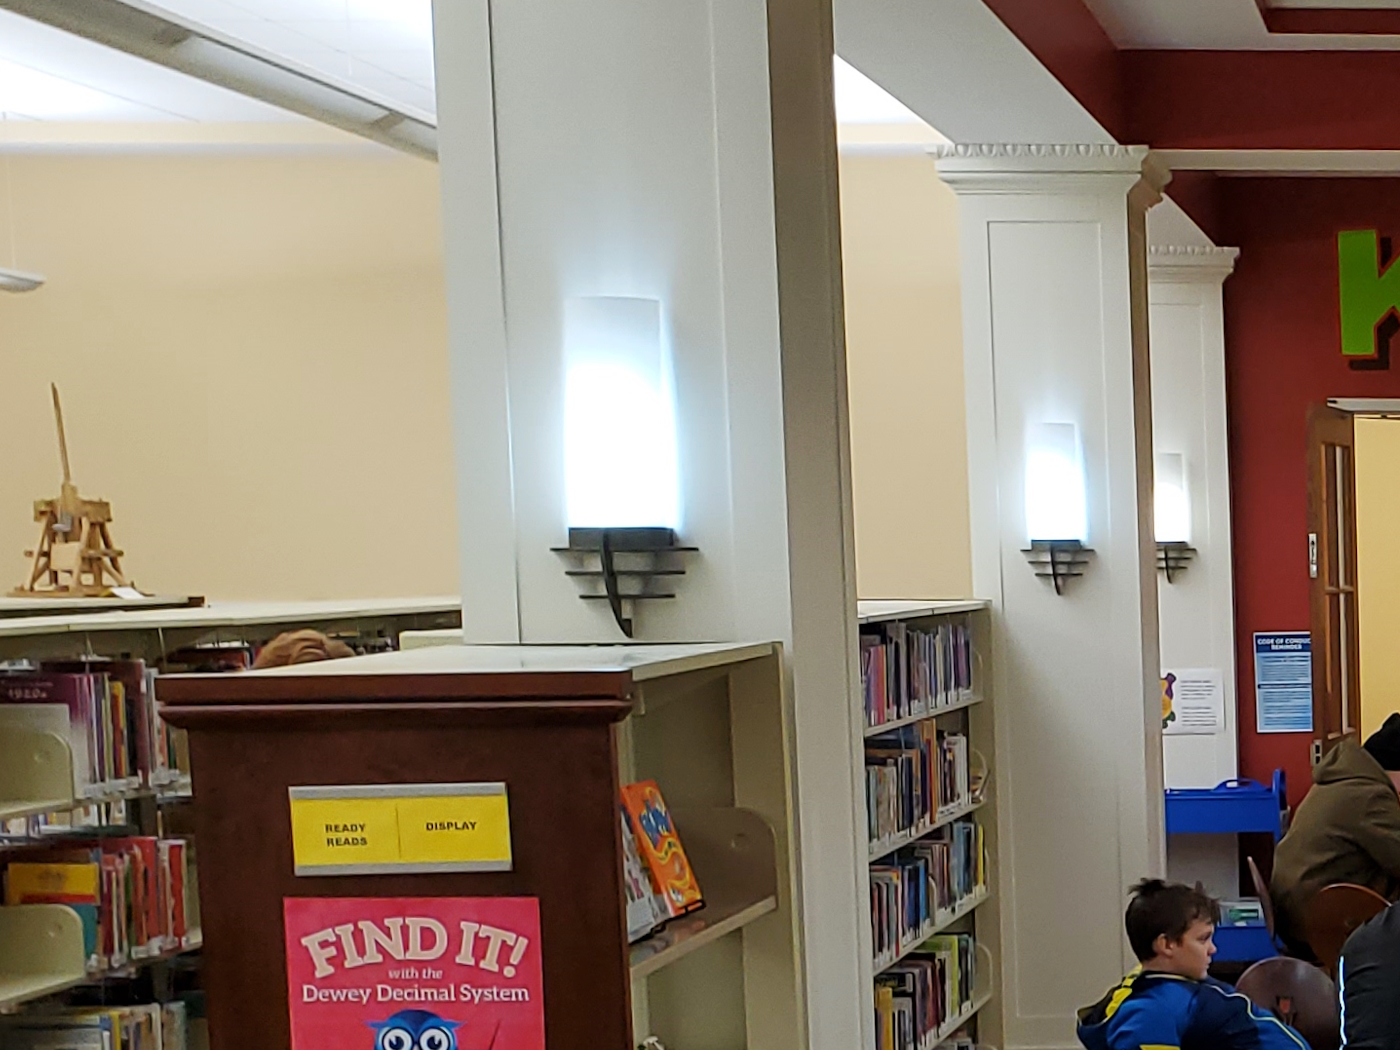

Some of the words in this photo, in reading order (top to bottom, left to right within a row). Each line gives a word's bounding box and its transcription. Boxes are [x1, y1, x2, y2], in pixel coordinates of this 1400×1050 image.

[325, 823, 366, 833] READY
[425, 821, 478, 832] DISPLAY
[326, 837, 368, 847] READS
[301, 916, 448, 979] FIND
[455, 920, 529, 978] IT!
[388, 967, 419, 980] with
[422, 967, 443, 980] the
[302, 984, 371, 1004] Dewey
[376, 983, 455, 1001] Decimal
[459, 983, 529, 1004] System
